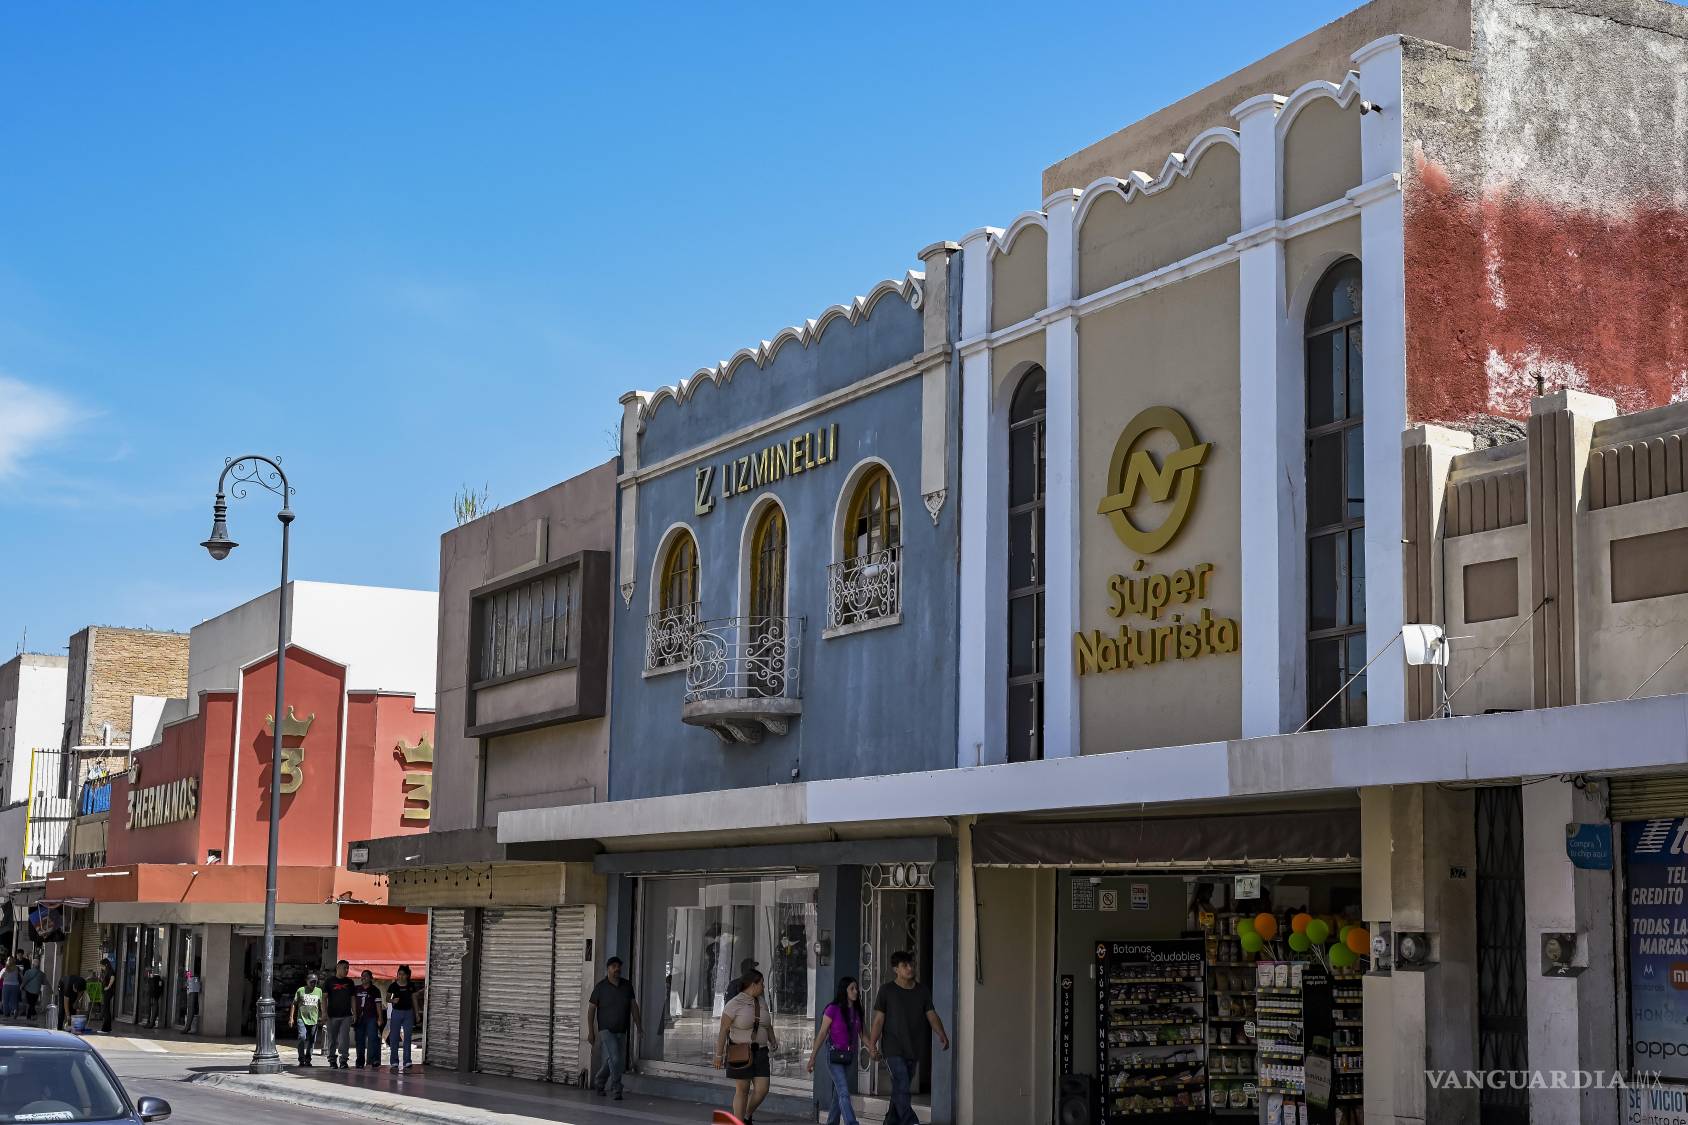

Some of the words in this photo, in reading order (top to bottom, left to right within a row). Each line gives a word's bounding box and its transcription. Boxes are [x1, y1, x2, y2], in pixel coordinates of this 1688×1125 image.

[721, 423, 839, 498] LIZMINELLI
[1107, 559, 1213, 620] Súper
[1074, 608, 1240, 675] Naturista
[1631, 887, 1683, 905] CREDITO
[1633, 918, 1670, 935] TODAS
[1673, 918, 1688, 935] LA
[1113, 944, 1152, 954] Botanas
[1640, 938, 1688, 955] MARCAS
[1635, 1041, 1688, 1059] oppo
[1629, 1088, 1683, 1112] SEVICIO
